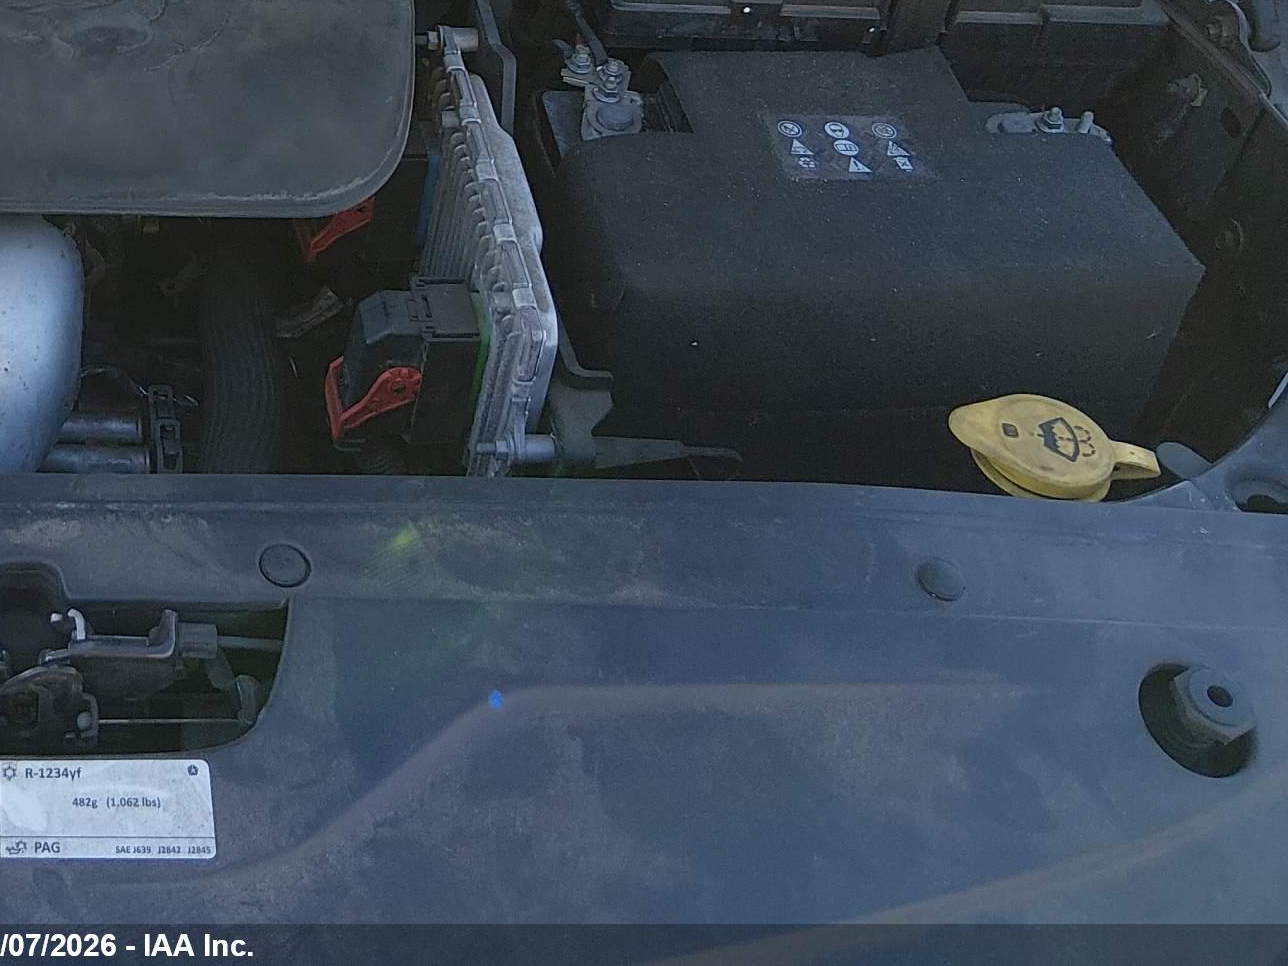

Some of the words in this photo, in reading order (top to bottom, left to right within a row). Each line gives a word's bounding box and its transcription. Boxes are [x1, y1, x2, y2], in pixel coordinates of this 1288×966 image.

[25, 767, 82, 781] R-1234yf
[72, 797, 98, 809] 482g
[142, 797, 161, 809] lbs)
[34, 841, 60, 853] PAG
[115, 845, 131, 854] SAE
[132, 845, 151, 854] J639
